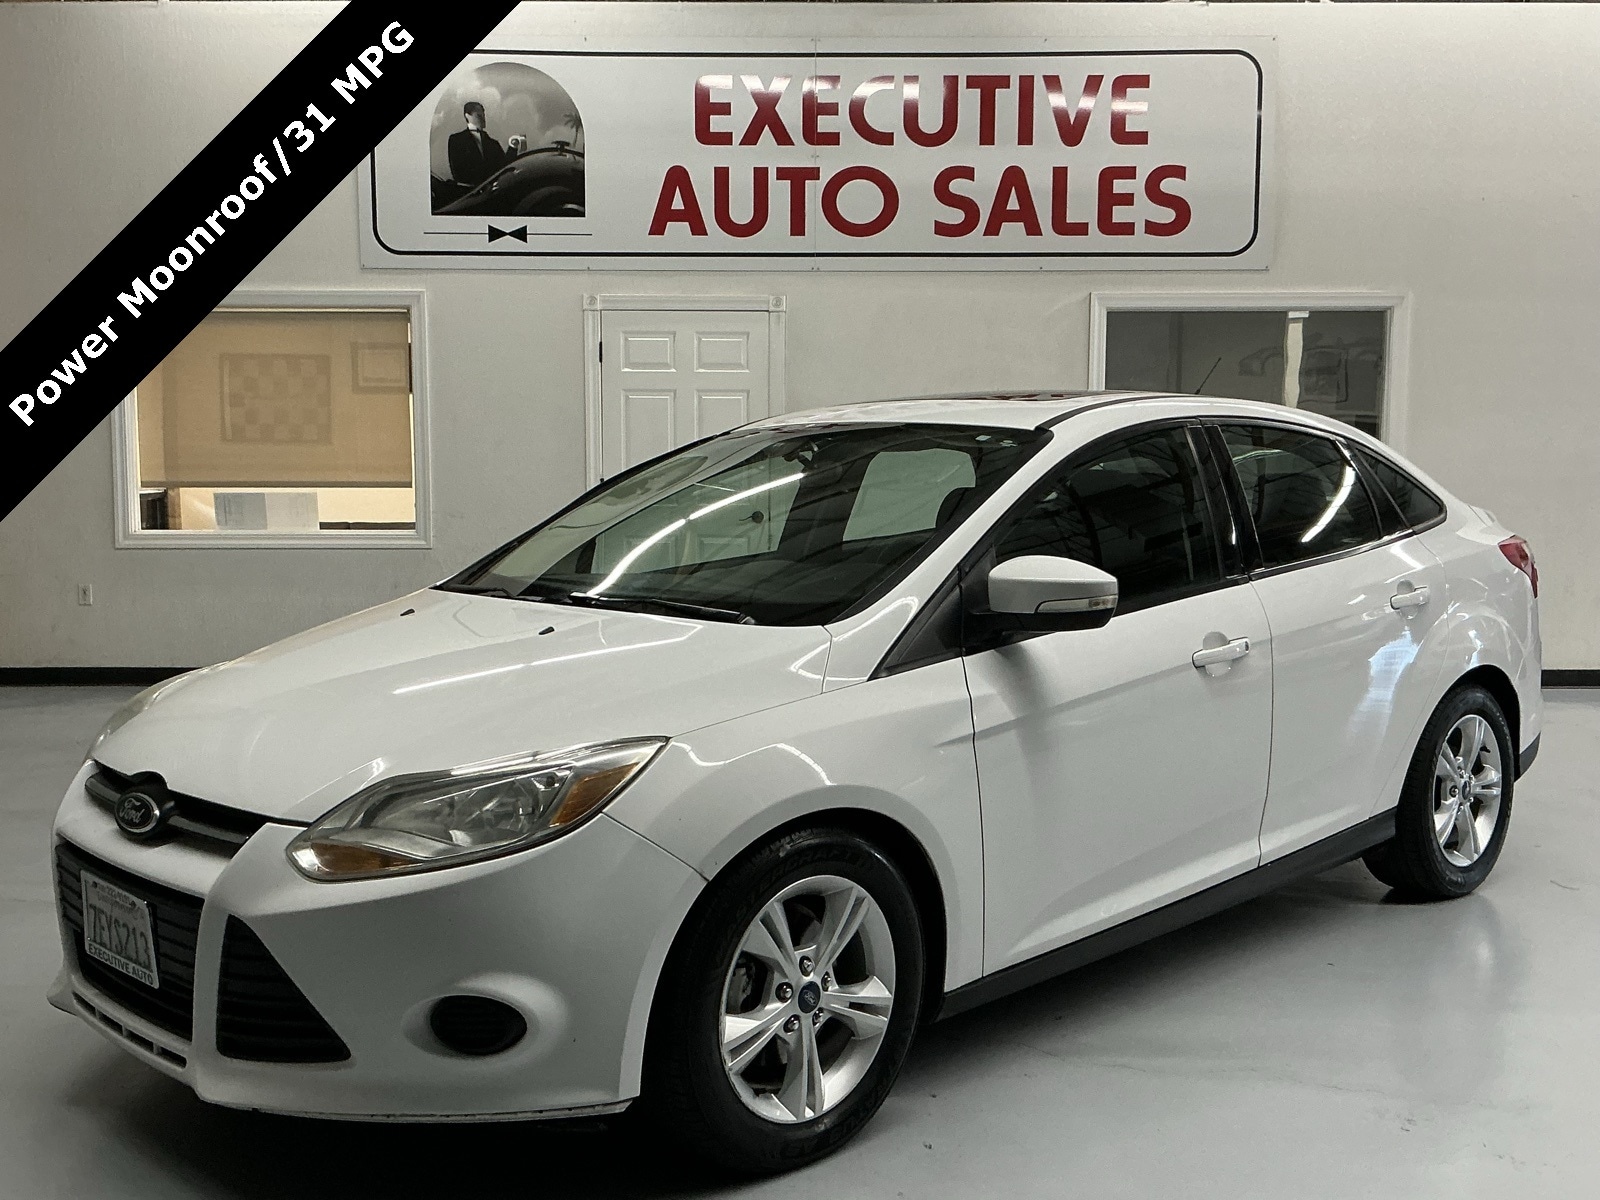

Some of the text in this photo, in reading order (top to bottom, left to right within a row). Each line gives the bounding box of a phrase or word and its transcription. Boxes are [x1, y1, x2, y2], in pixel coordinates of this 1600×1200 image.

[694, 75, 1150, 147] EXECUTIVE
[648, 165, 1192, 238] AUTO SALES
[120, 797, 146, 823] Ford
[88, 903, 154, 974] 7EYS213
[88, 943, 154, 986] EXECUTIVE AUTO
